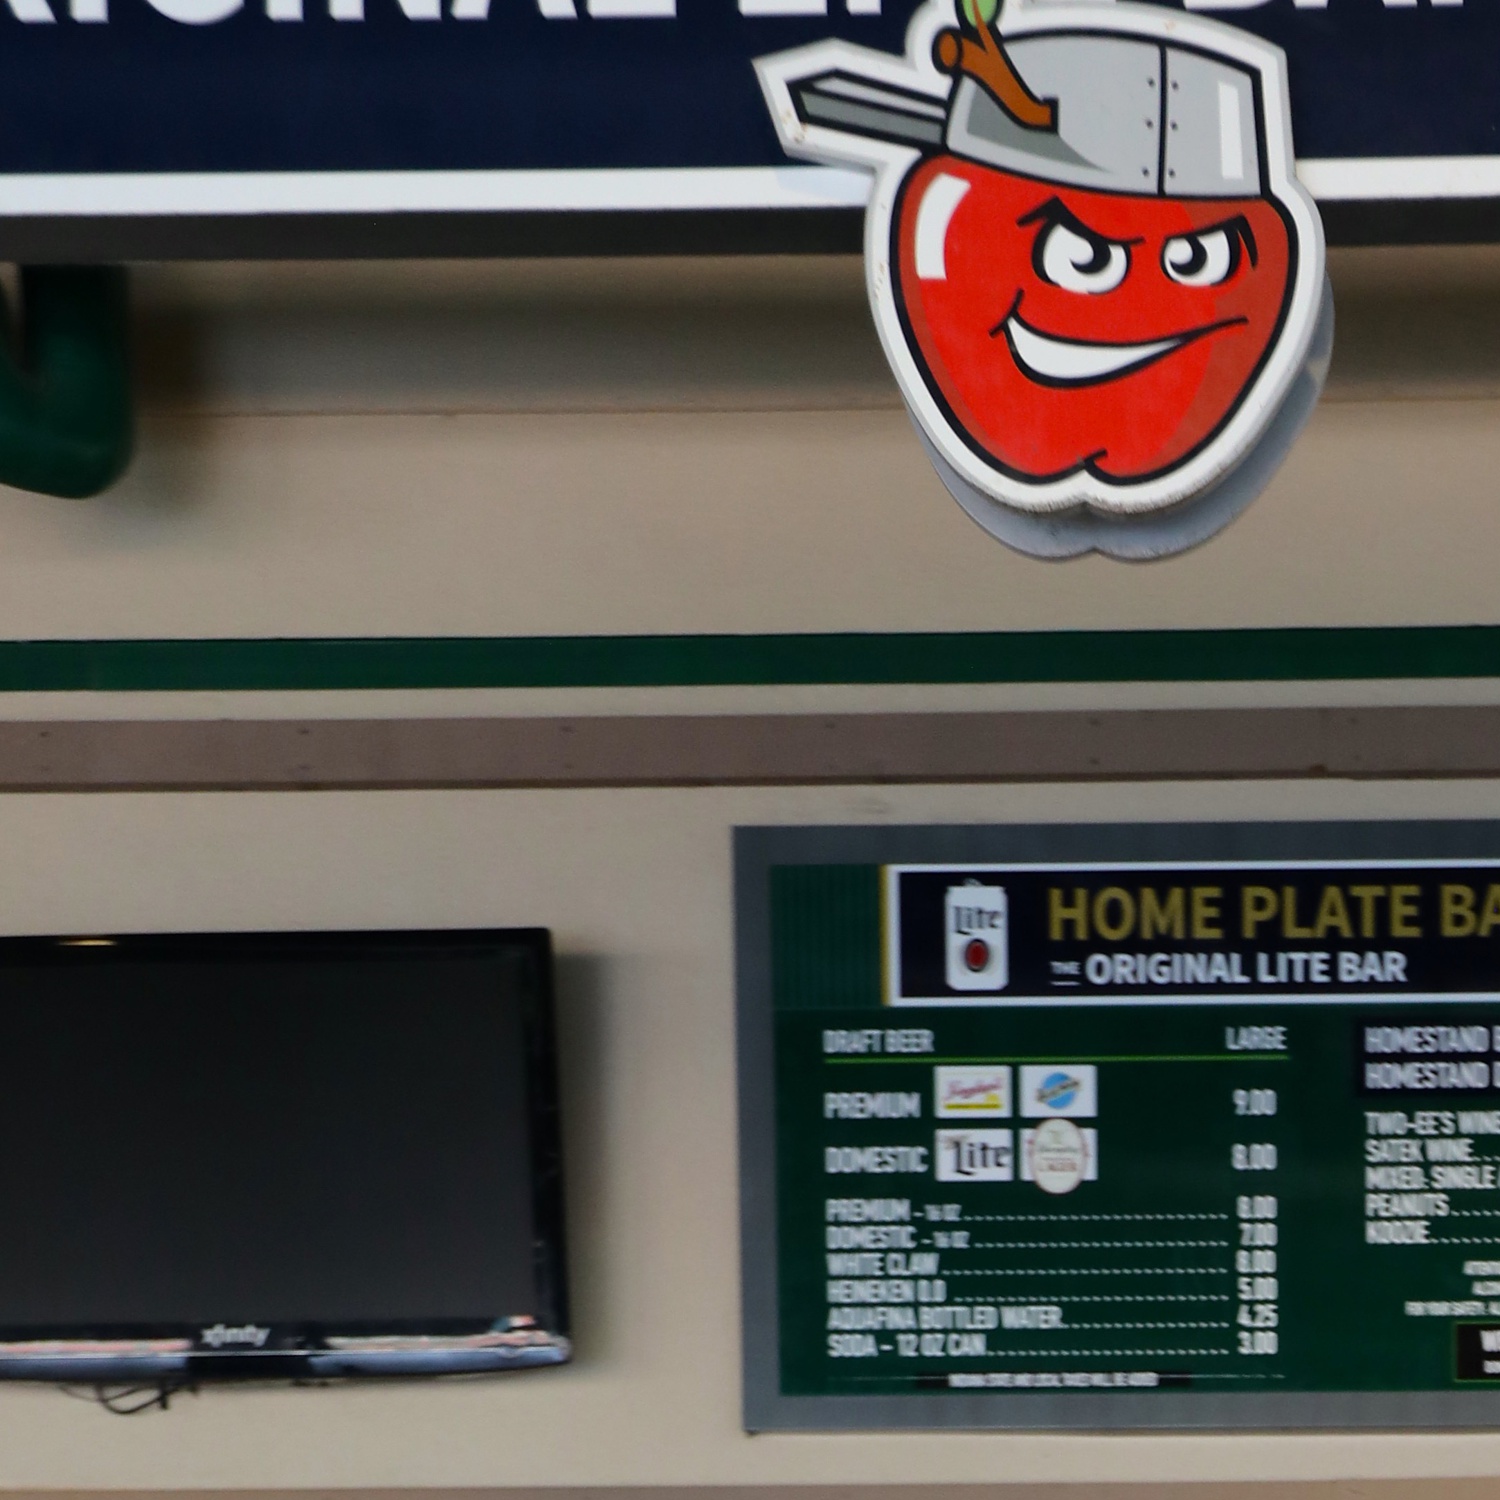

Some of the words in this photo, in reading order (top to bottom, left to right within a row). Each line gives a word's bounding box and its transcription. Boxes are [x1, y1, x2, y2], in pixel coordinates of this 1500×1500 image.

[1049, 886, 1223, 941] HOME
[1241, 884, 1422, 940] PLATE
[1085, 952, 1251, 985] ORIGINAL
[1257, 951, 1331, 983] LITE
[1338, 951, 1408, 983] BAR
[822, 1029, 883, 1053] DRAFT
[885, 1029, 934, 1053] BEER
[1225, 1026, 1288, 1050] LARGE
[1364, 1026, 1490, 1053] HOMESTAND
[1364, 1061, 1490, 1089] HOMESTAND
[823, 1092, 921, 1119] PREMIUM
[1232, 1088, 1277, 1116] 9.00
[824, 1146, 928, 1174] DOMESTIC
[1425, 1138, 1474, 1162] WINE
[1430, 1165, 1497, 1189] SINGLE
[825, 1199, 911, 1222] PREMIUM
[1365, 1193, 1449, 1217] PEANUTS
[825, 1226, 917, 1249] DOMESTIC
[1238, 1222, 1278, 1246] 7.00
[825, 1252, 885, 1276] WHITE
[886, 1252, 940, 1276] CLAW
[826, 1279, 915, 1303] HEINEKEN
[1237, 1276, 1279, 1300] 5.00
[918, 1305, 999, 1330] BOTTLED
[1236, 1304, 1279, 1328] 4.25
[827, 1333, 878, 1357] SODA
[947, 1333, 987, 1357] CAN
[1237, 1331, 1278, 1355] 3.00
